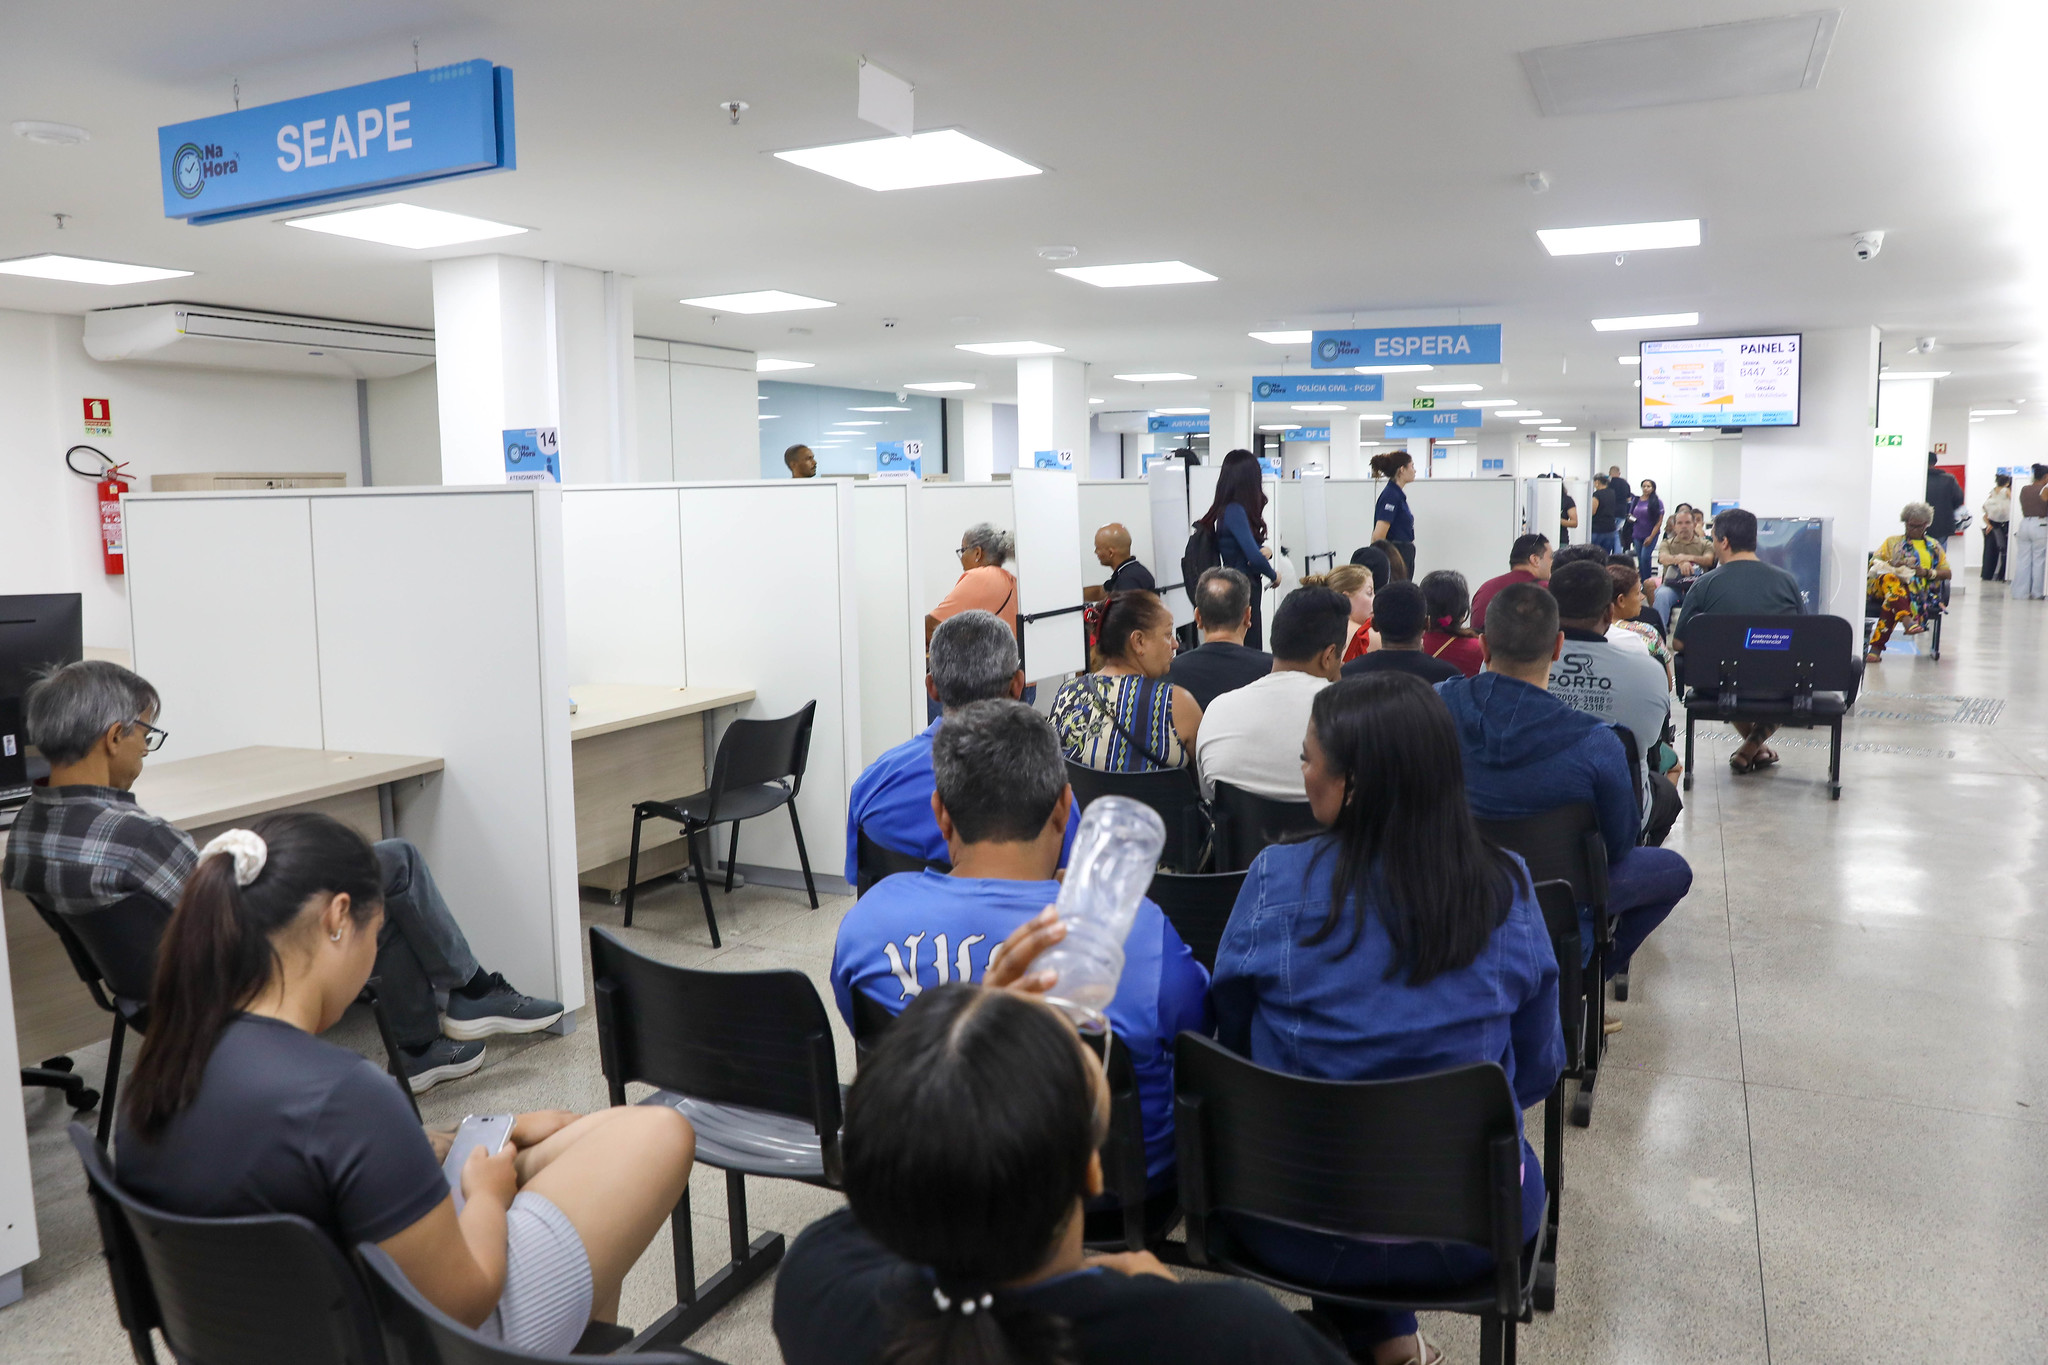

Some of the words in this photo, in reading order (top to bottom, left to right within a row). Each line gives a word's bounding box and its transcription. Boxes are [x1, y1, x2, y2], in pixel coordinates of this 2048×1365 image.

[276, 100, 413, 173] SEAPE
[204, 143, 223, 159] Na
[203, 160, 238, 179] Hora
[1374, 335, 1471, 357] ESPERA
[1740, 342, 1784, 354] PAINEL
[1788, 342, 1796, 352] 3
[1777, 366, 1789, 376] 32
[1296, 383, 1326, 392] POLÍCIA
[1328, 384, 1348, 392] CIVIL
[1354, 384, 1376, 392] PCDF
[1172, 420, 1196, 428] JUSTIÇA
[1433, 413, 1458, 424] MTE
[540, 431, 557, 447] 14
[1306, 430, 1317, 438] DF
[906, 443, 920, 454] 13
[1060, 452, 1071, 461] 12
[1562, 653, 1594, 676] SR
[1549, 674, 1612, 690] PORTO
